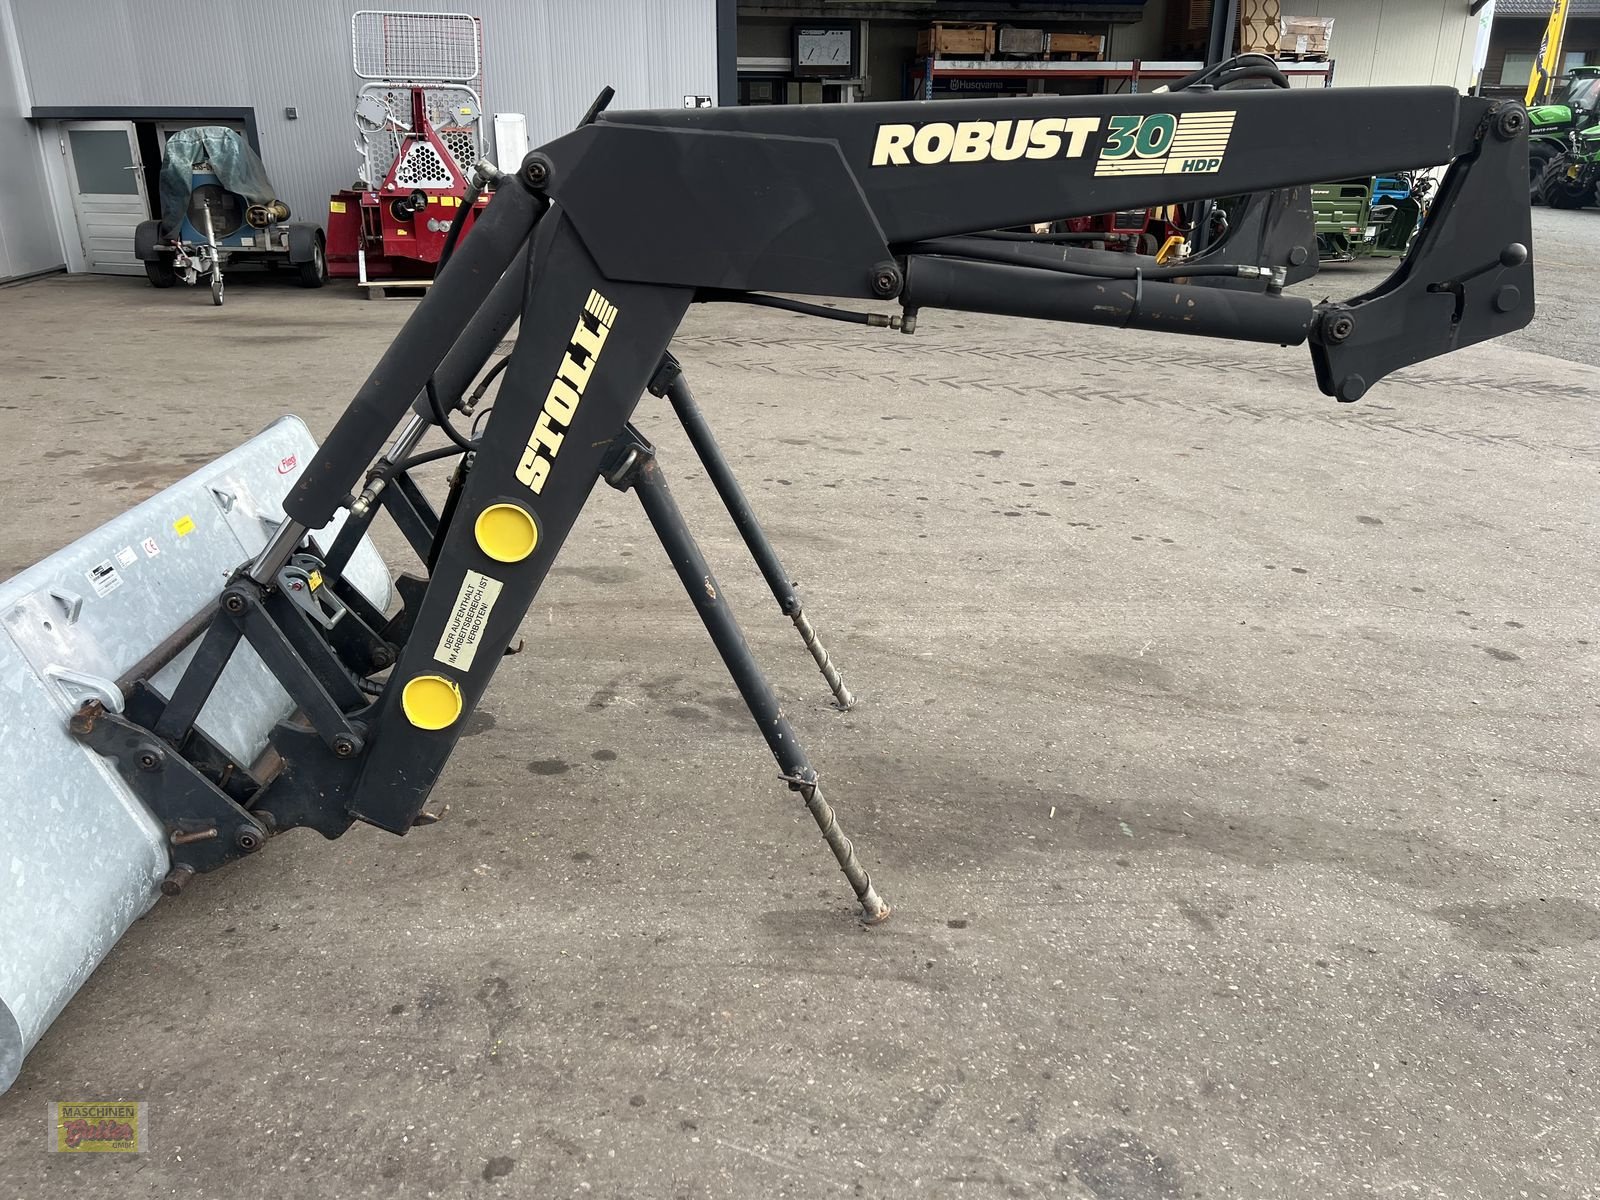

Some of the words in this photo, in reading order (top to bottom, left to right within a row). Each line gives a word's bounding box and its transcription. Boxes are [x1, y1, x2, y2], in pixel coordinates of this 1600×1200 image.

[960, 80, 1004, 91] Husqvarna
[872, 116, 1101, 167] ROBUST
[1100, 113, 1177, 161] 30
[1181, 158, 1220, 172] HDP
[515, 314, 610, 495] STOLL
[443, 632, 456, 650] DER
[451, 583, 475, 633] AUFENTHALT
[448, 653, 458, 664] IM
[454, 589, 484, 655] ARBEITSBEREICH
[479, 576, 489, 590] IST
[466, 602, 489, 645] VERBOTEN!
